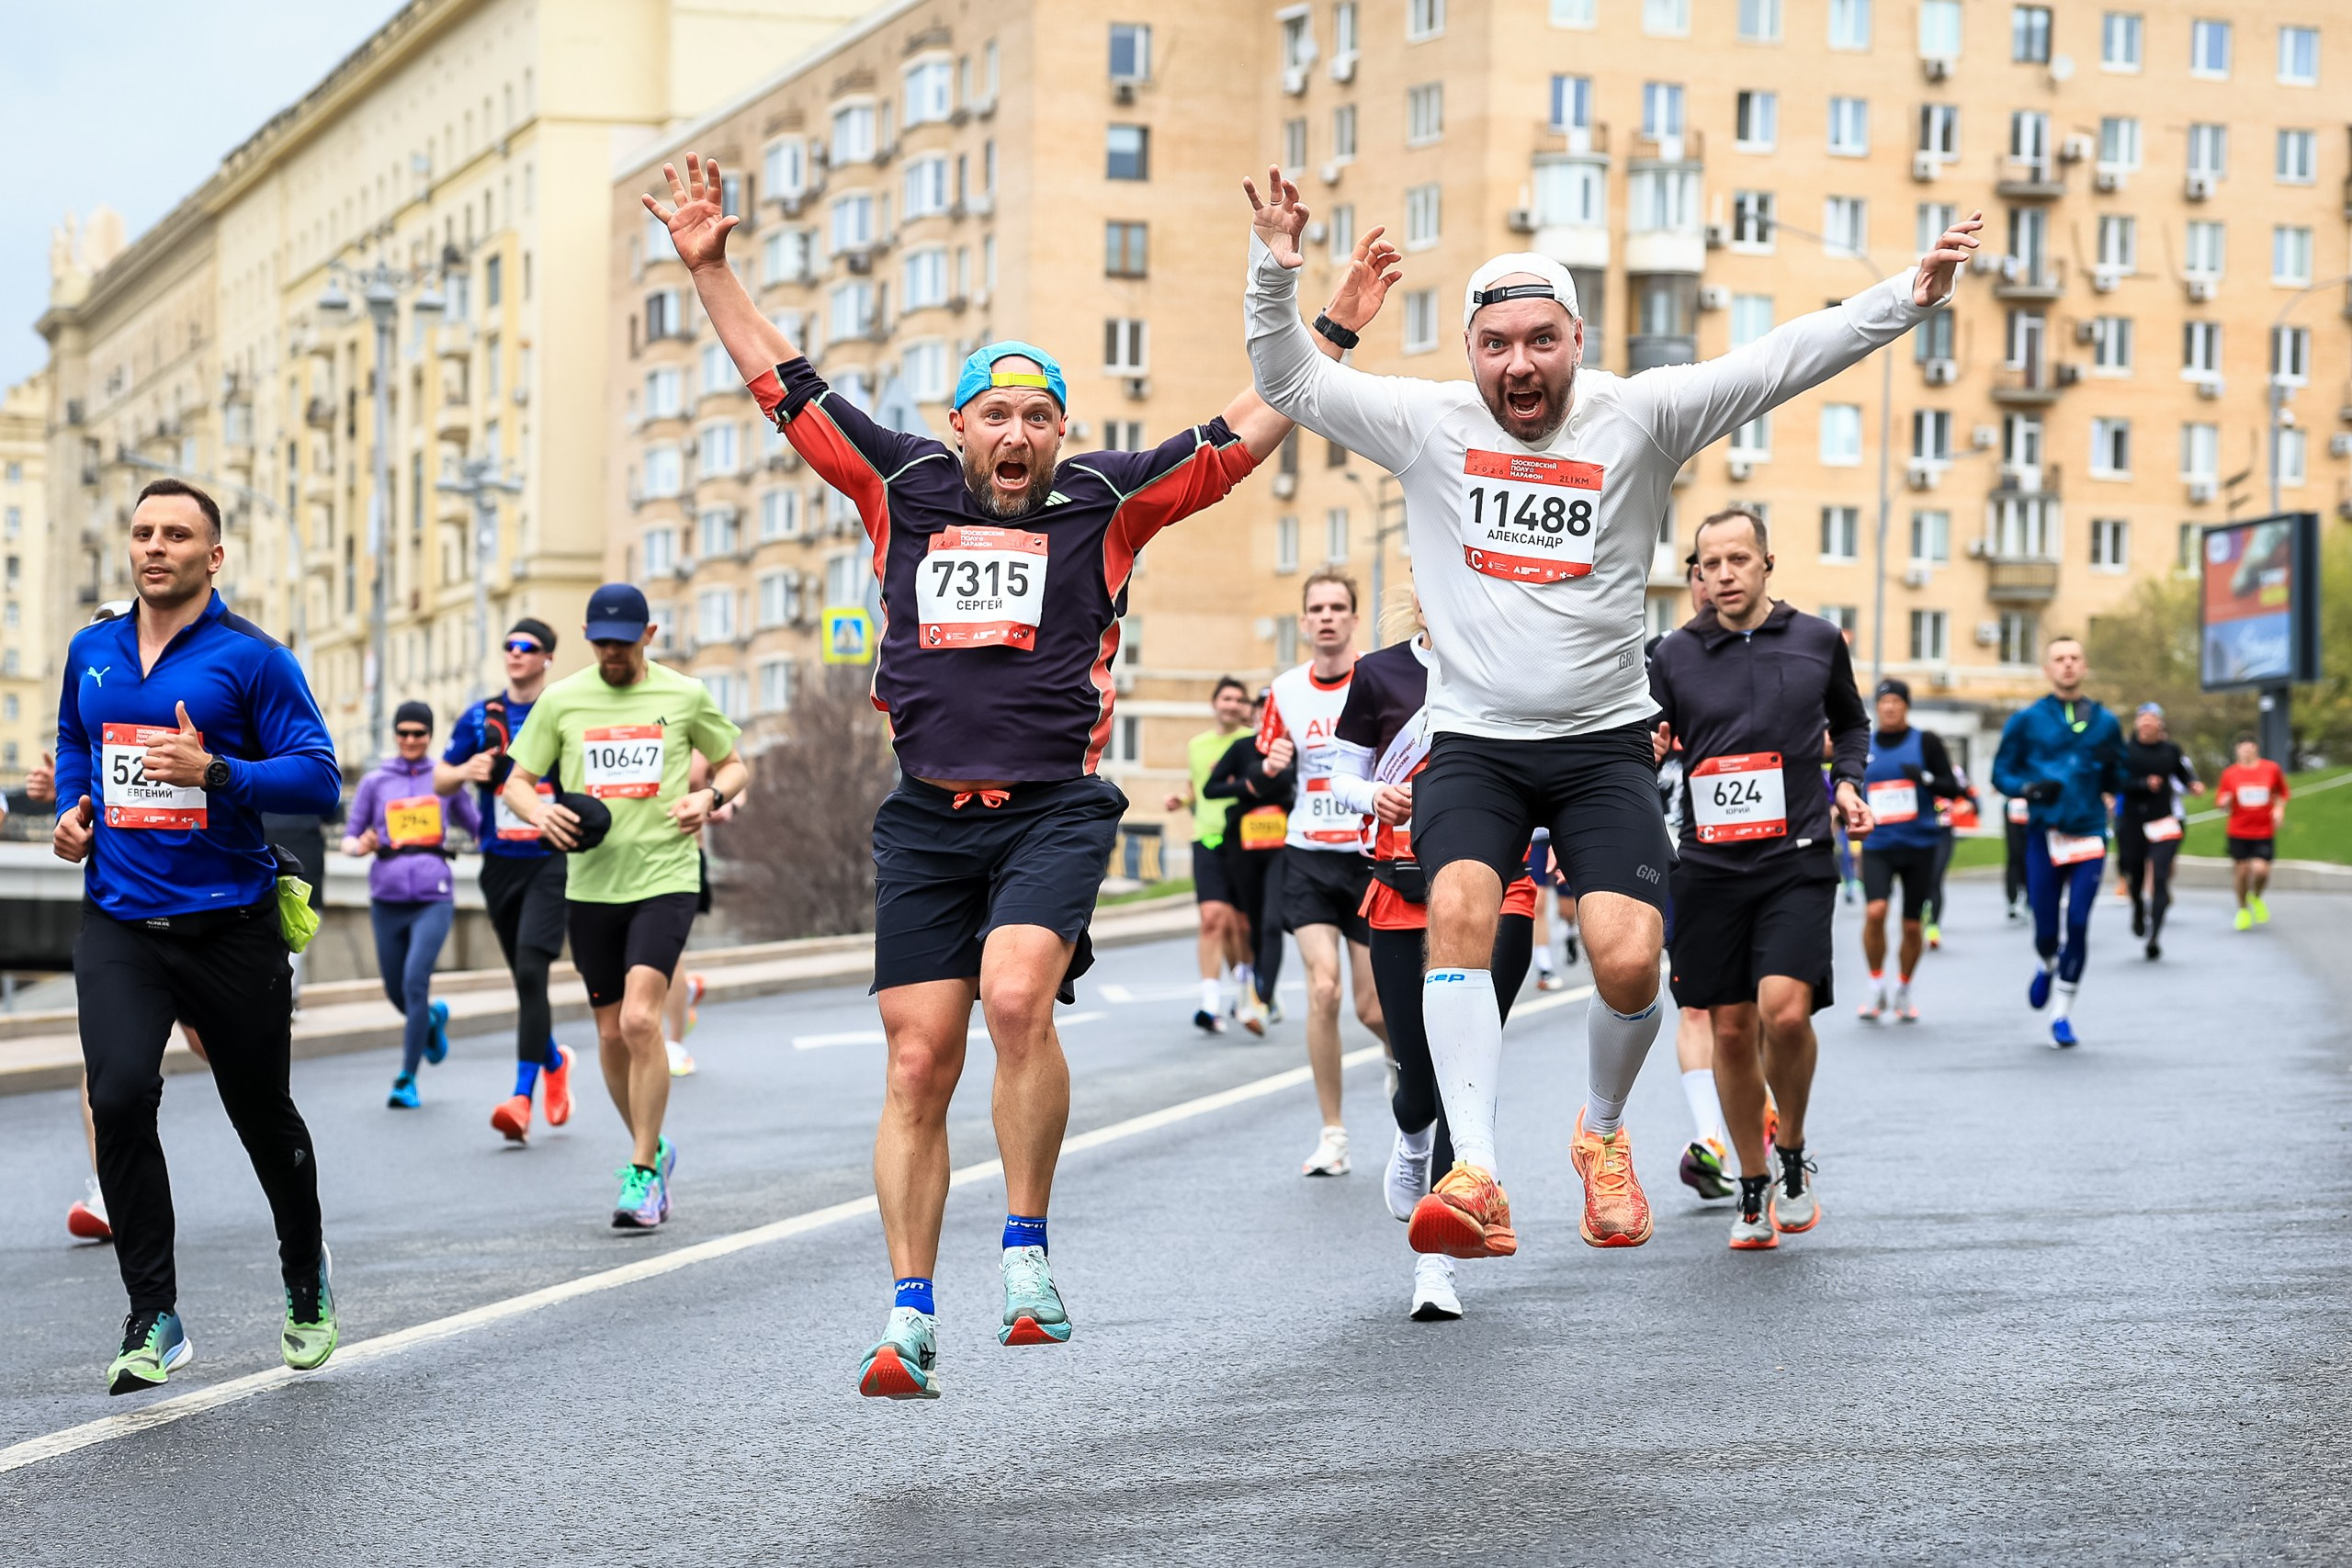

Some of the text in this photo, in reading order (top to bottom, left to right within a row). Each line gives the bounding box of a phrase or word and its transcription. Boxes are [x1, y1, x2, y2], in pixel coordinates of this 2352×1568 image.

[1511, 458, 1557, 470] МОСКОВСКИЙ
[1510, 471, 1544, 480] МАРАФОН
[1469, 487, 1592, 536] 11488
[1487, 529, 1564, 548] АЛЕКСАНДР
[932, 560, 1029, 597] 7315
[956, 598, 1002, 611] СЕРГЕЙ
[588, 747, 659, 769] 10647
[113, 754, 164, 787] 52
[127, 788, 173, 798] ЕВГЕНИЙ
[1713, 779, 1762, 807] 624
[1313, 797, 1357, 817] 810
[1426, 974, 1465, 984] cep
